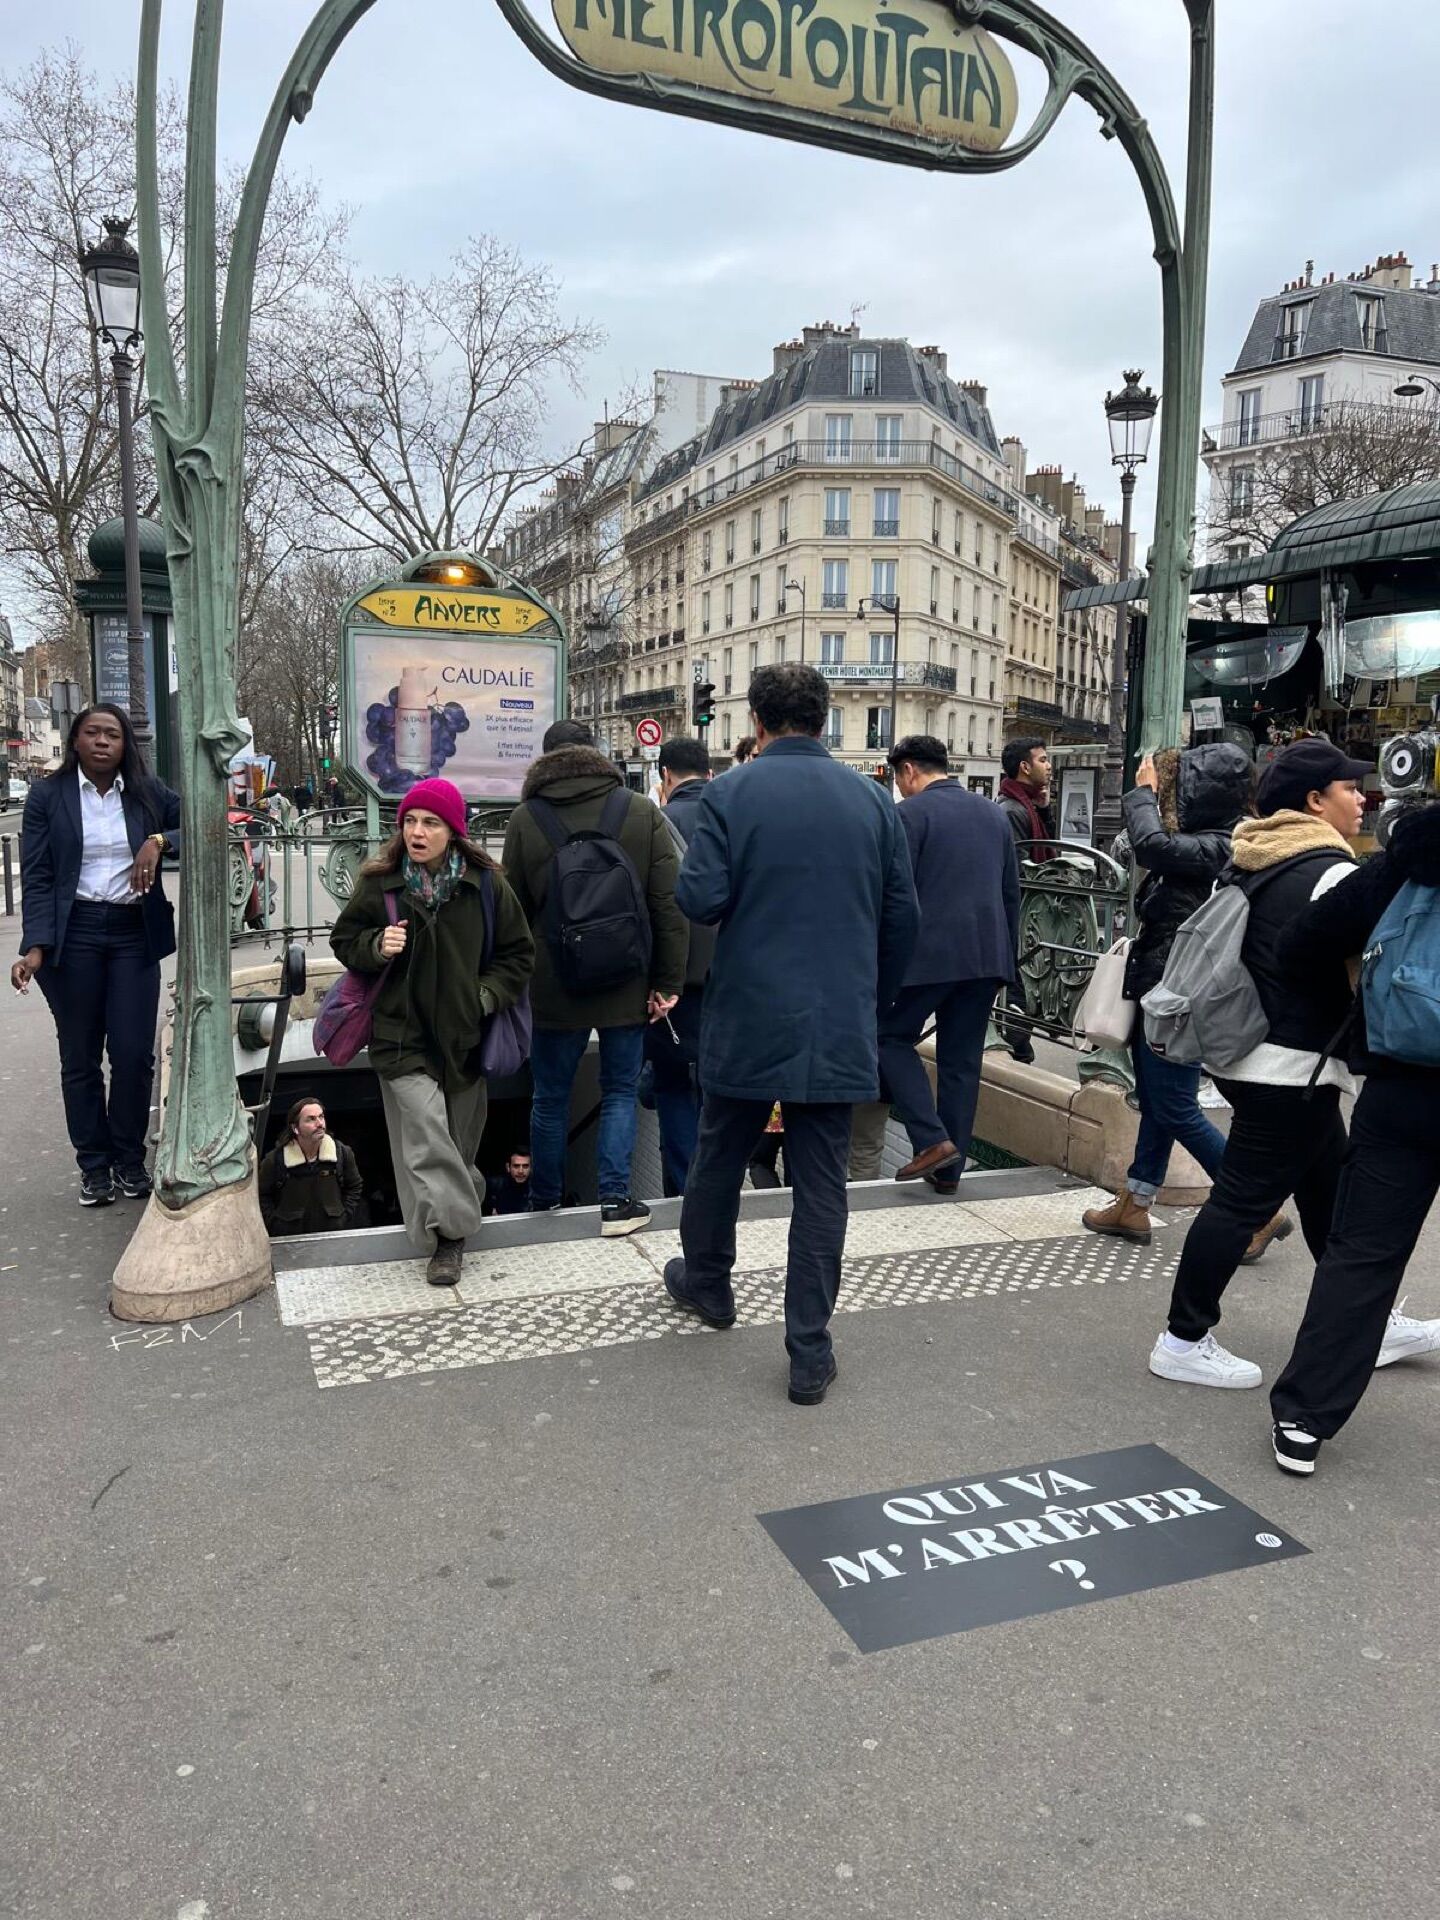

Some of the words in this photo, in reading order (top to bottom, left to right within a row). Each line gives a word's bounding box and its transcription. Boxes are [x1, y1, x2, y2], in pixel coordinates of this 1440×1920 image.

[414, 595, 501, 628] ANVERS
[882, 1482, 1010, 1525] QUI
[998, 1469, 1098, 1500] VA
[1048, 1558, 1095, 1590] ?
